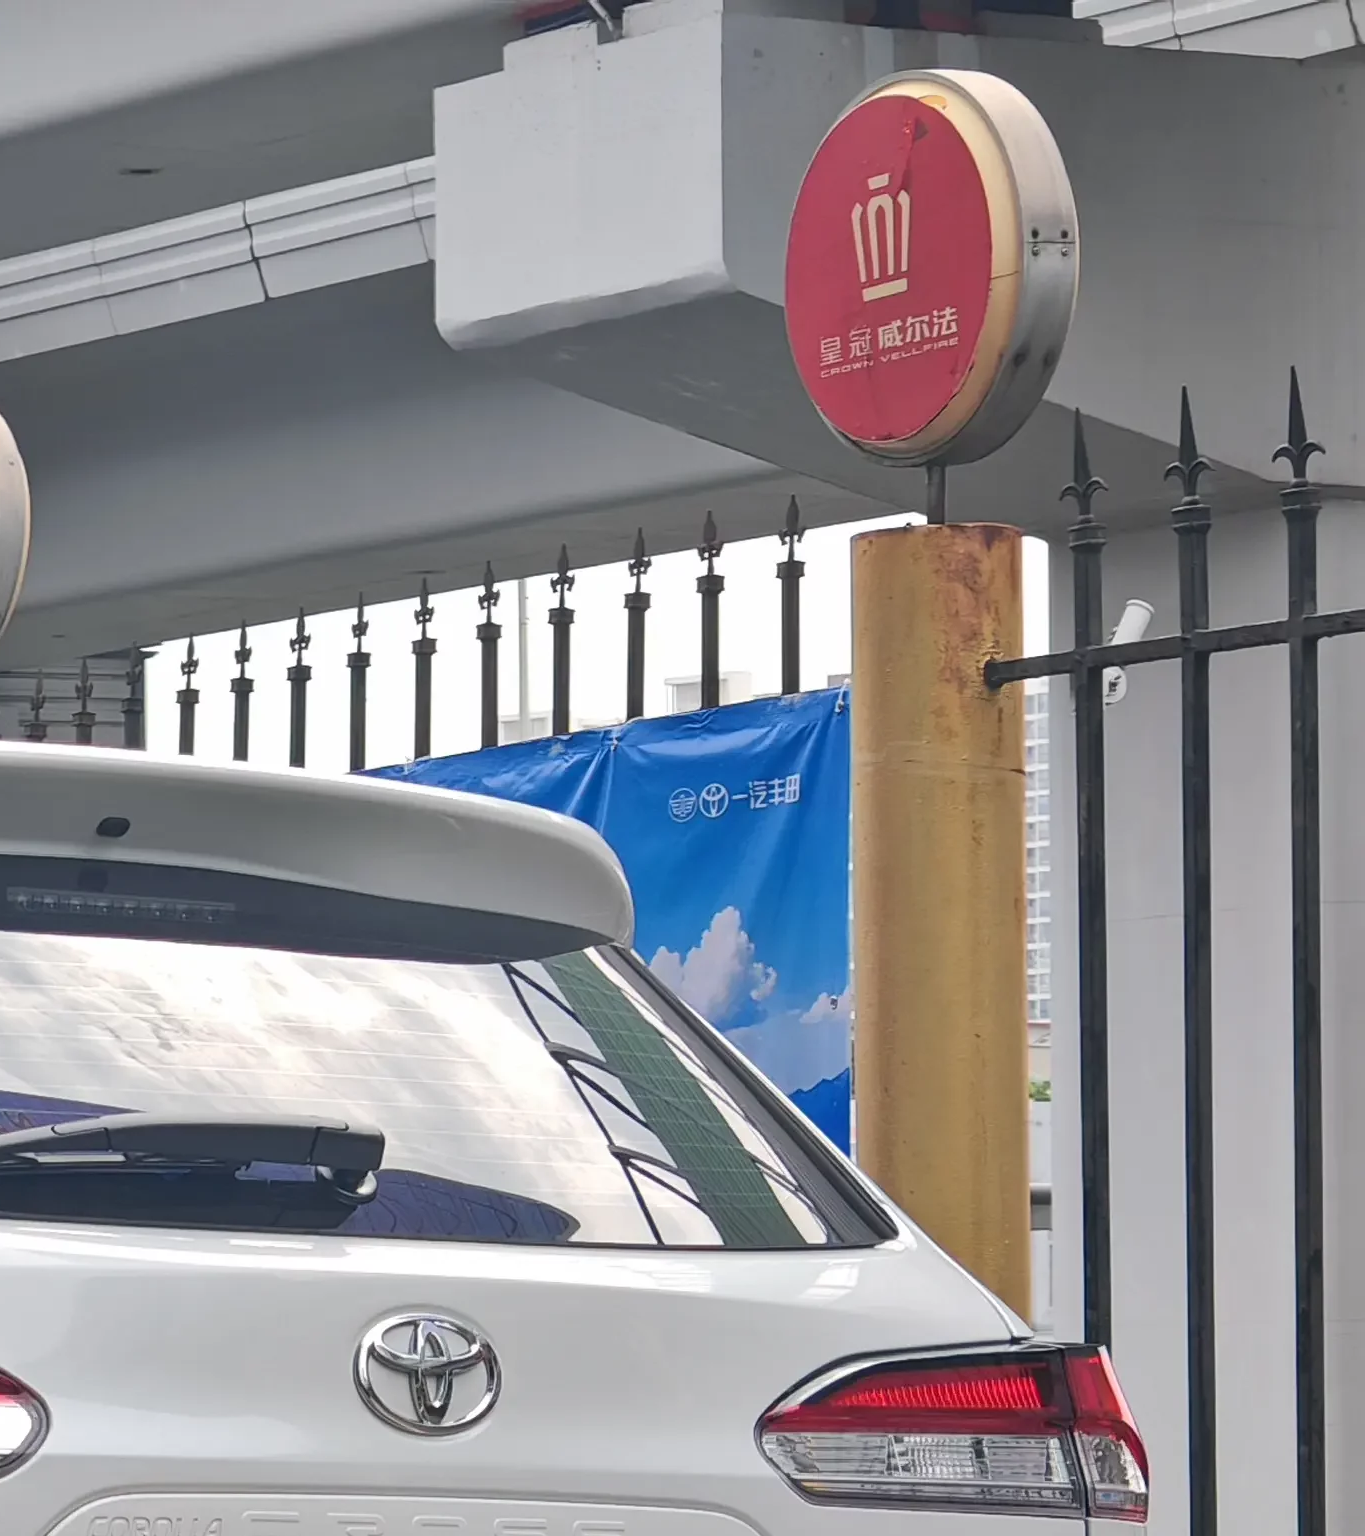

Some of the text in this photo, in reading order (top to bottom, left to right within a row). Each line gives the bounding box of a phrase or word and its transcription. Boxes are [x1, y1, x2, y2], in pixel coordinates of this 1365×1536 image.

[820, 337, 959, 378] CROWN VELLFIRE
[731, 773, 801, 810] 一汽丰田
